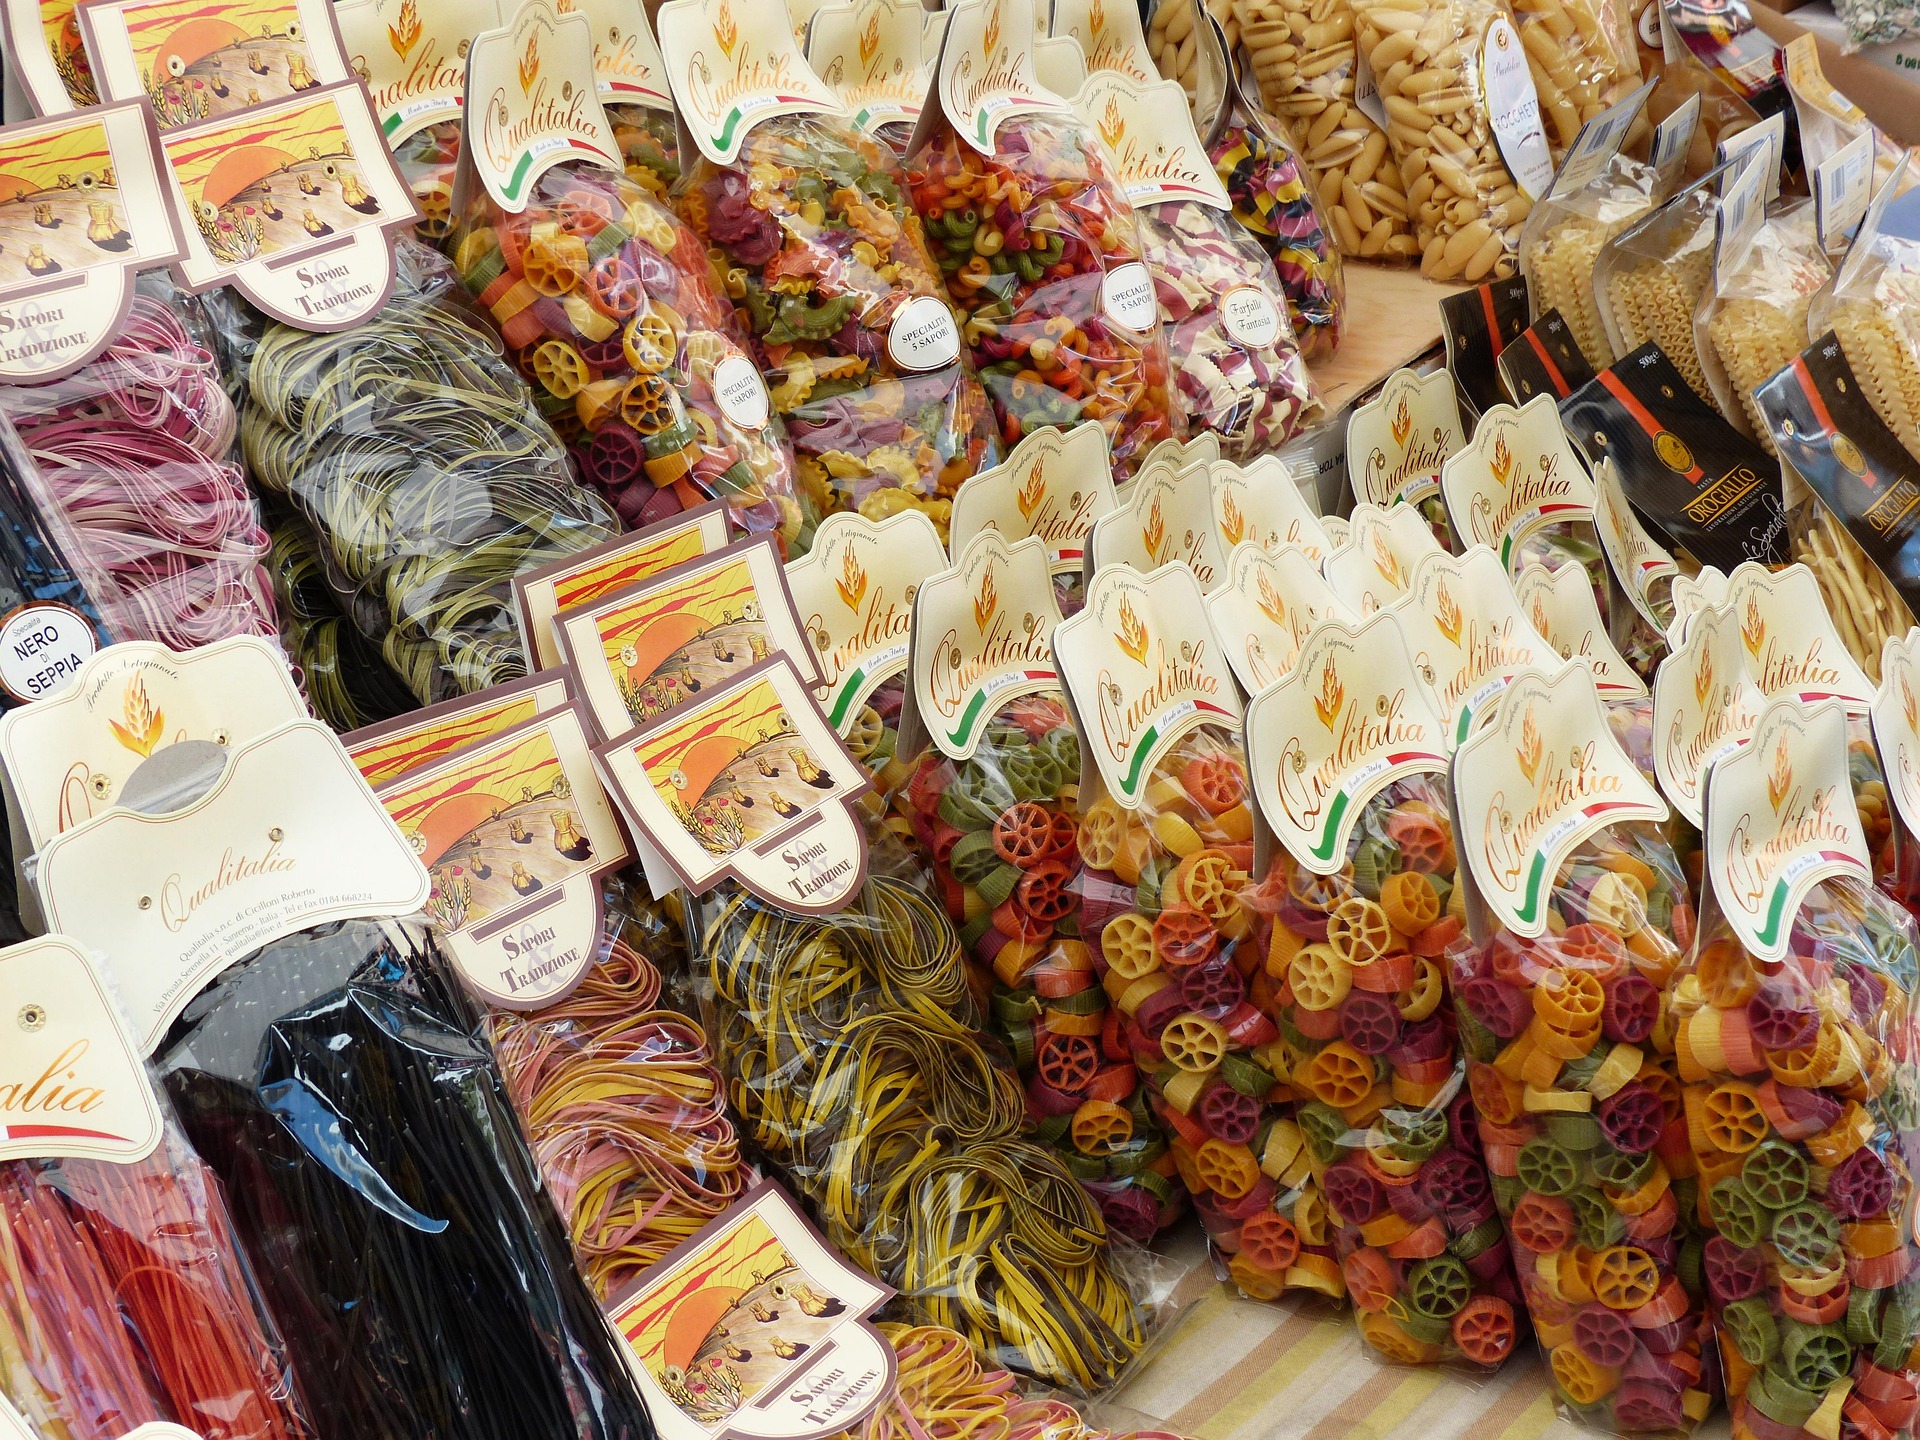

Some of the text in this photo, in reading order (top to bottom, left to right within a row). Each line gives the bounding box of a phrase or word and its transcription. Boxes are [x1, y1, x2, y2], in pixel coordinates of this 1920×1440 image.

[687, 41, 811, 127] Qualitalia
[950, 51, 1033, 126] Qualitalia
[484, 77, 599, 173] Qualitalia
[294, 282, 376, 319] TRADIZIONE
[1121, 303, 1127, 312] 5
[1229, 299, 1262, 318] Farfalle
[1235, 317, 1272, 332] Fantasia
[0, 331, 90, 363] RADIZIONE
[911, 329, 950, 352] 5 SAPORI
[736, 386, 757, 406] SAPORI
[1687, 467, 1757, 523] OROGIALLO
[1696, 477, 1714, 491] PASTA
[1868, 480, 1919, 531] OROGIALLO
[13, 625, 60, 661] NERO
[40, 651, 51, 664] DI
[26, 652, 84, 695] SEPPIA
[85, 658, 180, 714] Prodotto Artigianale
[1098, 638, 1220, 763] Qualitalia
[1277, 688, 1426, 832] Qualitalia
[1484, 740, 1623, 893] Qualitalia
[1726, 784, 1851, 914] Qualitalia
[160, 838, 297, 933] Qualitalia
[787, 857, 854, 900] TRADIZIONE
[179, 887, 316, 963] Qualitalia s.n.c. di Cicilloni Roberto
[224, 921, 284, 957] qualitalia@live.it
[152, 1001, 166, 1014] Via
[162, 978, 184, 1002] Privata
[180, 950, 212, 980] Serenella
[222, 923, 255, 945] Sanremo
[259, 911, 279, 926] Italia
[283, 905, 296, 916] Tel
[303, 899, 318, 909] Fax
[318, 894, 340, 906] 0184
[341, 892, 373, 903] 668224
[500, 946, 581, 995] TRADIZIONE
[800, 1369, 881, 1428] TRADIZIONE
